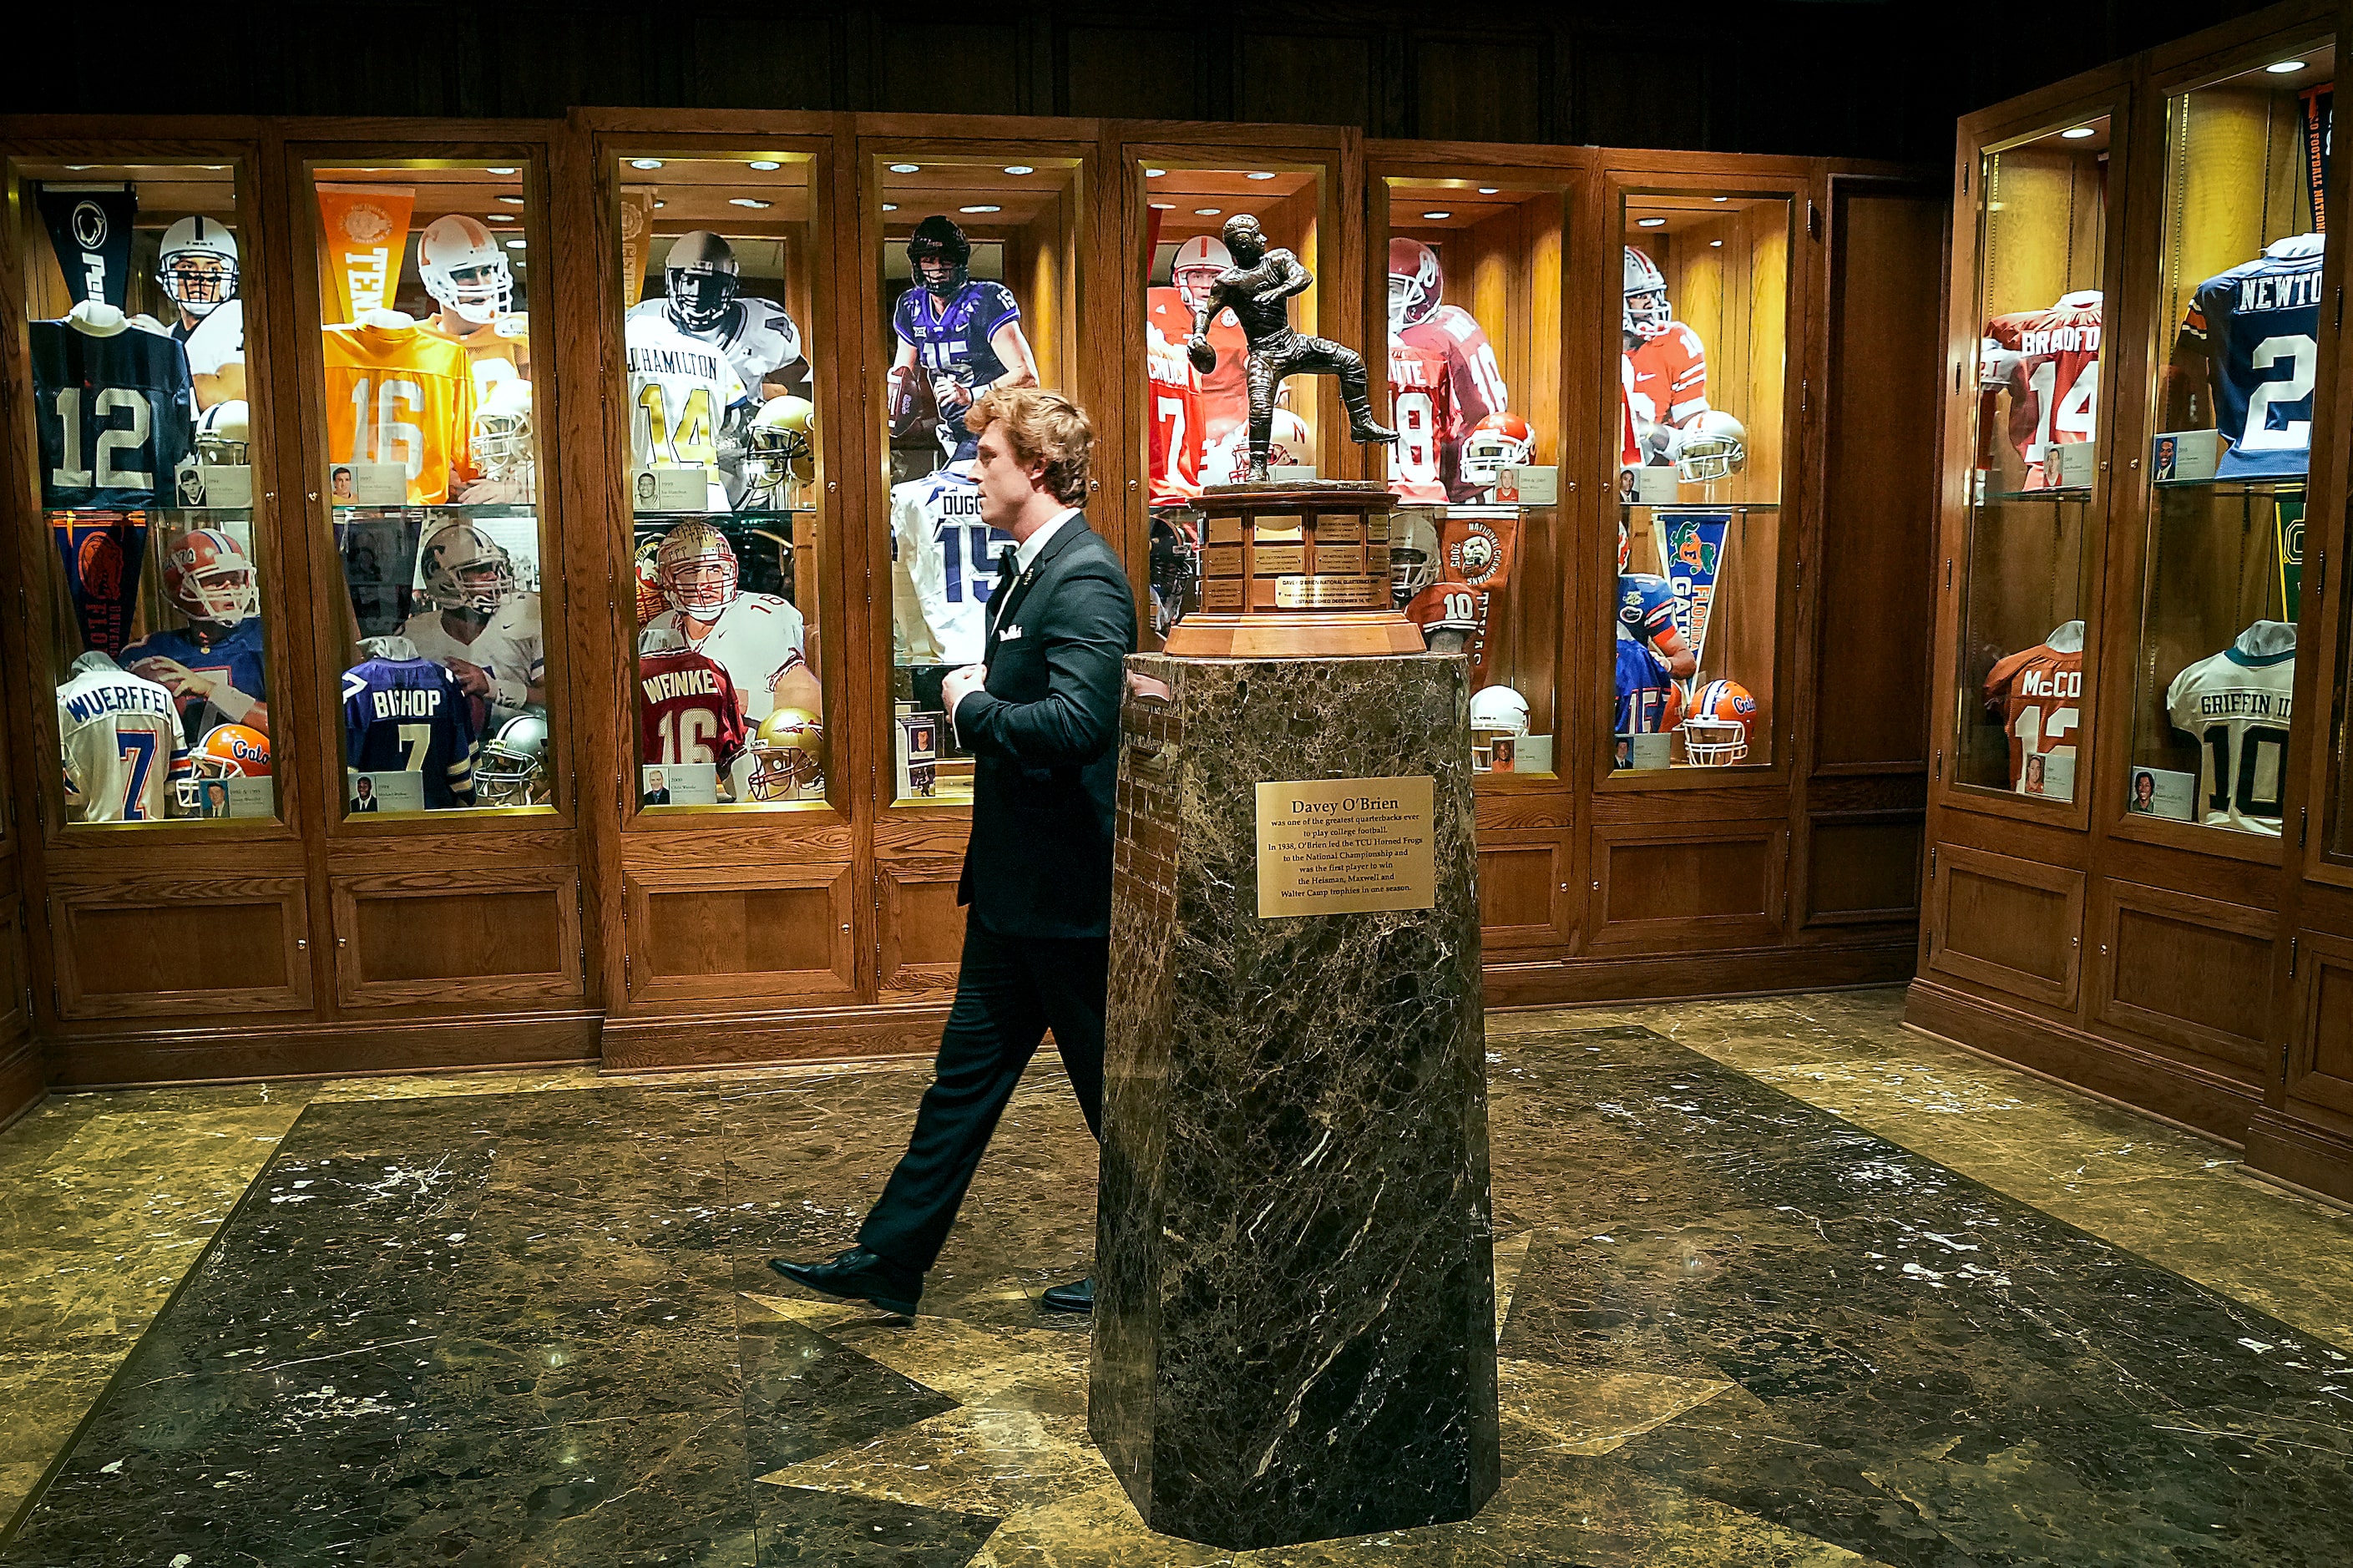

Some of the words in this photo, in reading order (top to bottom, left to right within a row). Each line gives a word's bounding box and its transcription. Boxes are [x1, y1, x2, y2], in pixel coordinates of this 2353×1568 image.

[2310, 134, 2323, 188] FOOTBALL
[996, 288, 1018, 311] 15
[641, 348, 717, 381] HAMILTON
[2240, 334, 2318, 450] 2
[351, 377, 424, 480] 16
[2024, 361, 2099, 463] 14
[53, 387, 154, 490] 12
[639, 383, 720, 485] 14
[1157, 395, 1187, 482] 7
[1293, 422, 1306, 444] N
[934, 526, 1016, 603] 15
[1450, 543, 1460, 568] 2005
[1467, 549, 1502, 586] CHAMPIONS
[1683, 550, 1698, 564] F
[1444, 593, 1474, 620] 10
[1690, 584, 1712, 651] FLORIDA
[67, 685, 171, 723] WUERFFEL
[642, 669, 718, 704] WEINKE
[2201, 693, 2271, 715] GRIFFIN
[398, 724, 431, 771] 7
[658, 707, 717, 764] 16
[116, 729, 158, 821] 7
[2203, 725, 2290, 818] 10
[1292, 801, 1338, 815] Davey
[1343, 797, 1399, 811] O'Brien
[1325, 817, 1354, 826] greatest
[1356, 814, 1402, 823] quarterbacks
[1278, 842, 1296, 851] 1938,
[1313, 830, 1328, 838] play
[1330, 828, 1356, 837] college
[1339, 851, 1393, 859] Championship
[1345, 863, 1369, 873] player
[1307, 889, 1328, 898] Camp
[1330, 888, 1359, 896] trophies
[1312, 876, 1346, 884] Heisman,
